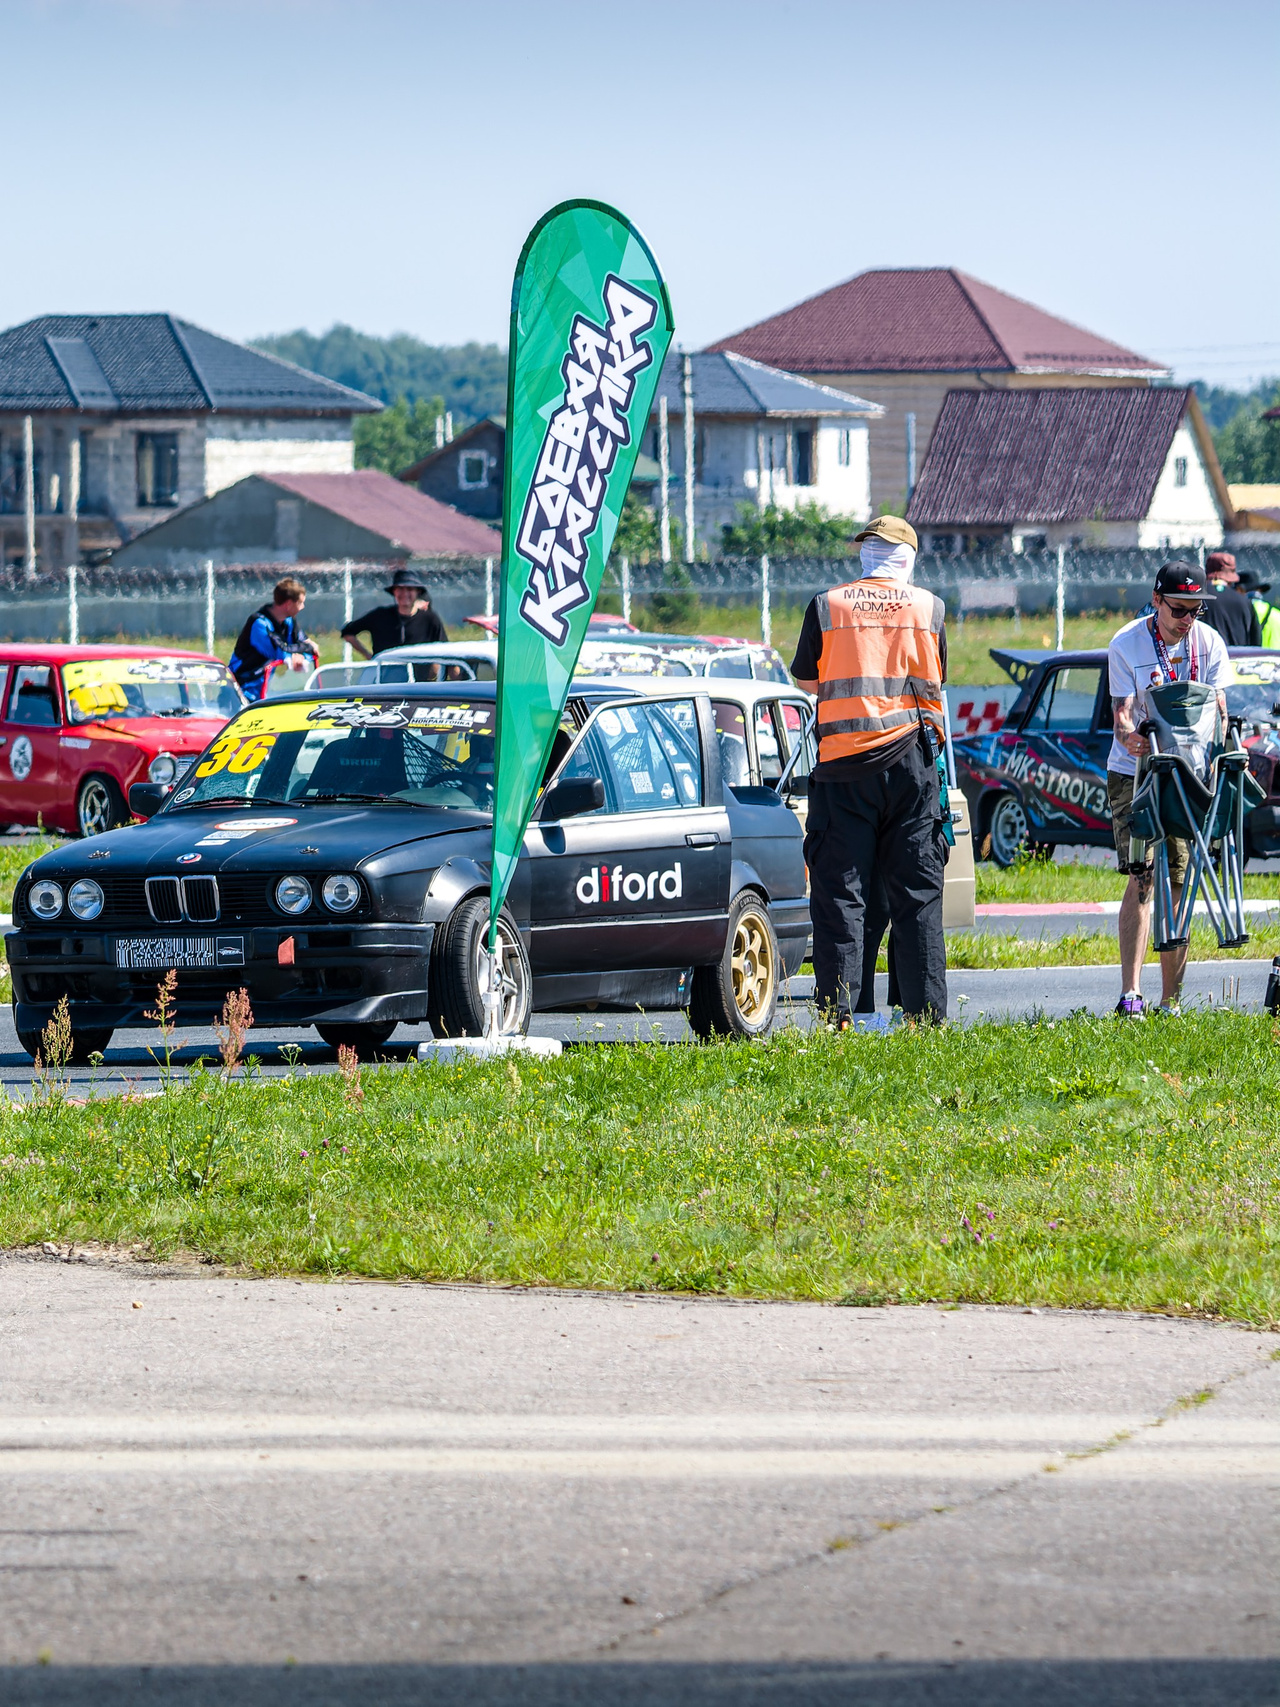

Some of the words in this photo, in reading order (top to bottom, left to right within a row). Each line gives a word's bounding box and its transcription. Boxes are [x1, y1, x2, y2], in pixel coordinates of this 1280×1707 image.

[520, 320, 608, 566] БОЕВАЯ
[523, 278, 654, 640] КЛАССИКА
[851, 611, 896, 620] RACEWAY
[852, 601, 884, 612] ADM
[412, 706, 490, 724] BATTLE
[195, 735, 277, 778] 36
[576, 862, 682, 904] diford
